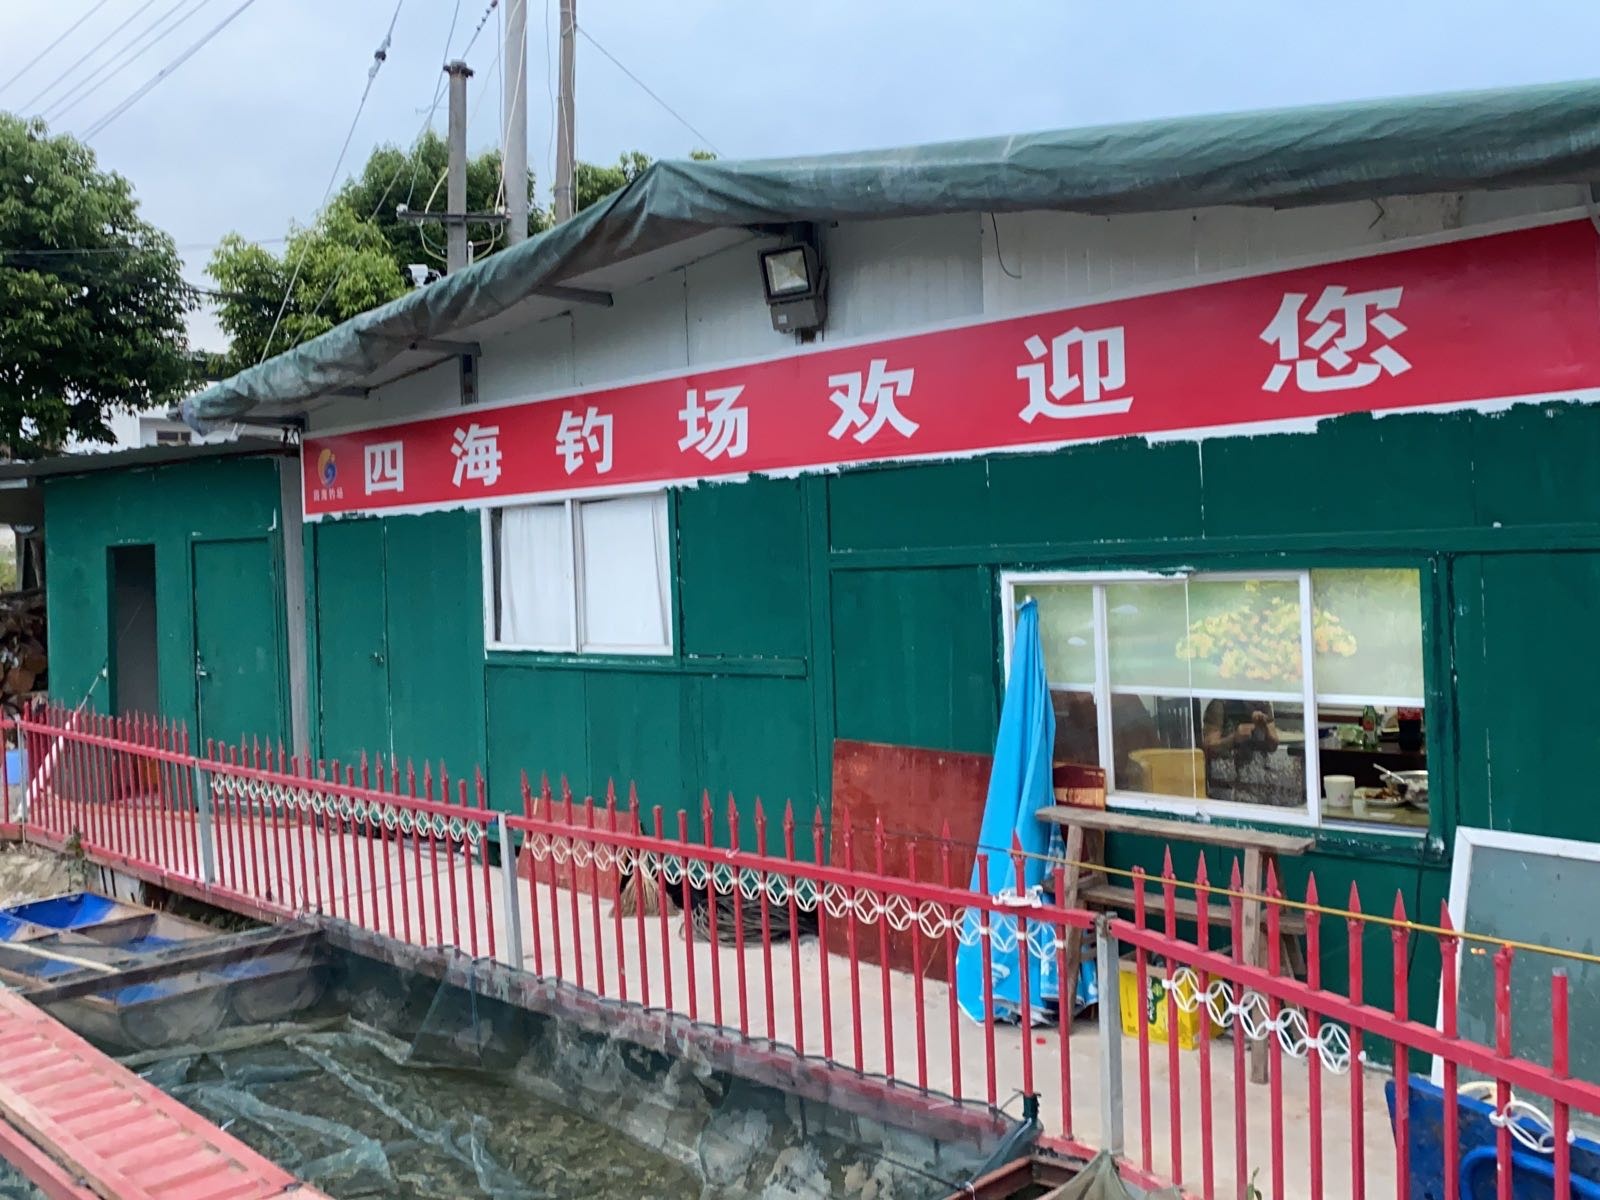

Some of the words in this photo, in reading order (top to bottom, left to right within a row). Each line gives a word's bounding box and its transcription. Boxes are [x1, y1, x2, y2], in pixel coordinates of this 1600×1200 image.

[364, 285, 1413, 496] 四海钓场欢迎您
